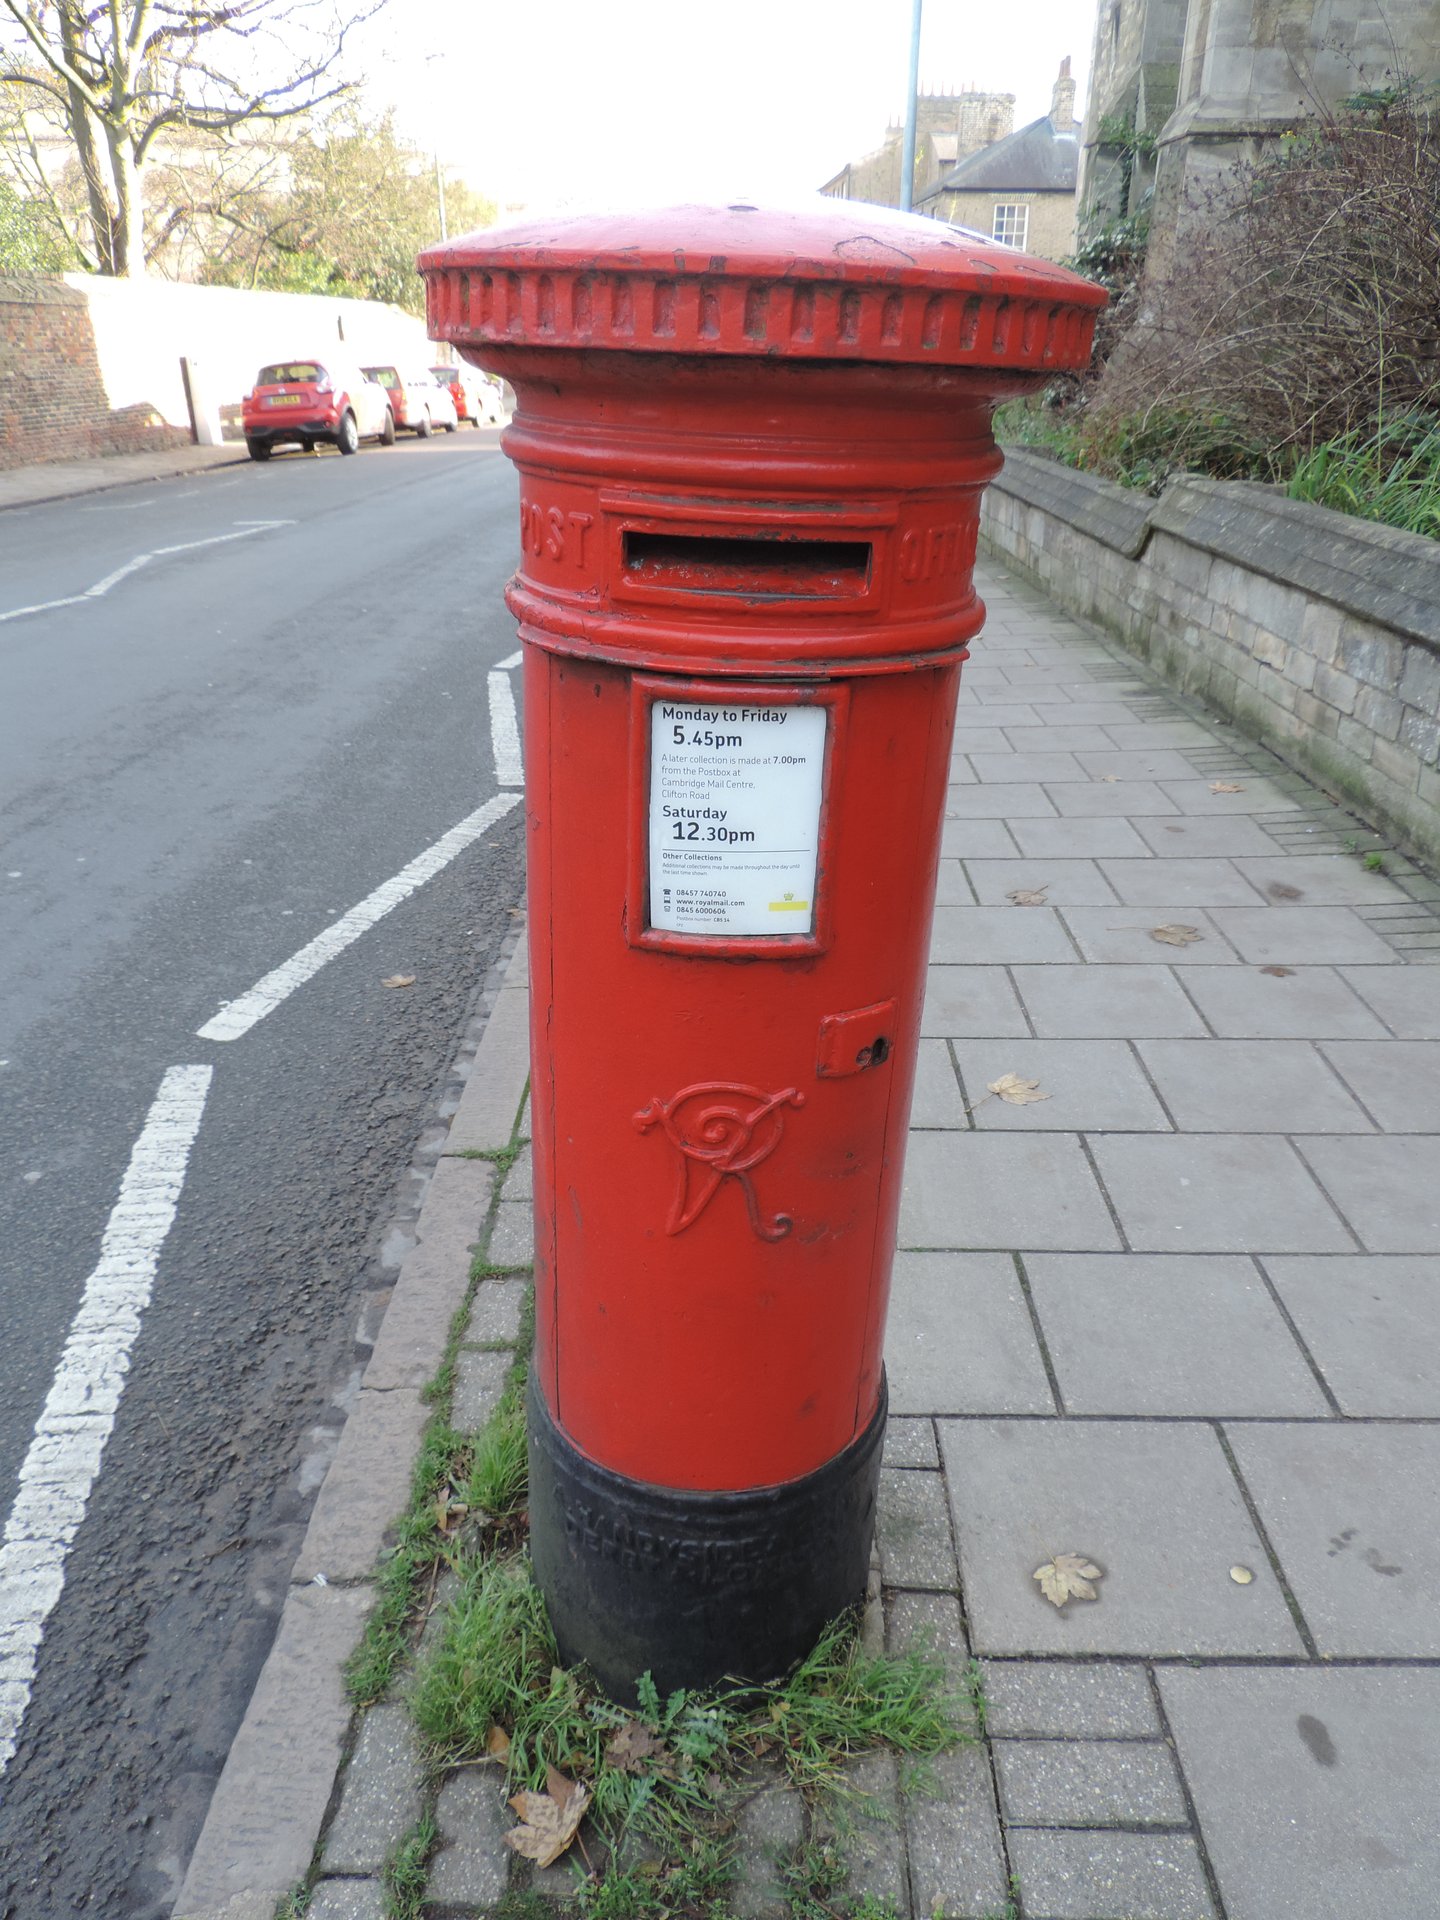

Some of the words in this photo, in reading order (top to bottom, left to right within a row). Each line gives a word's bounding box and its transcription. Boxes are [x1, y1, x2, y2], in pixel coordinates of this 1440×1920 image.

[662, 706, 719, 724] Monday
[723, 709, 737, 722] to
[741, 709, 788, 724] Friday
[673, 725, 743, 749] 5.45pm
[661, 754, 668, 762] A
[669, 754, 687, 763] later
[689, 755, 728, 764] collection
[730, 756, 737, 764] is
[738, 756, 761, 765] made
[763, 757, 771, 765] at
[772, 756, 806, 766] 7.00pm
[661, 766, 681, 775] from
[683, 767, 697, 775] the
[698, 768, 731, 777] Postbox
[732, 769, 741, 777] at
[661, 777, 706, 789] Cambridge
[707, 780, 725, 788] Mail
[726, 780, 756, 790] Centre,
[661, 790, 688, 799] Clifton
[689, 791, 710, 800] Road
[662, 805, 728, 822] Saturday
[672, 821, 755, 845] 12.30pm
[662, 853, 683, 861] Other
[684, 853, 723, 862] Collections
[676, 889, 698, 897] 08457
[699, 890, 727, 898] 740740
[676, 898, 745, 908] www.royalmail.com
[676, 906, 694, 914] 0845
[695, 907, 726, 915] 6000606
